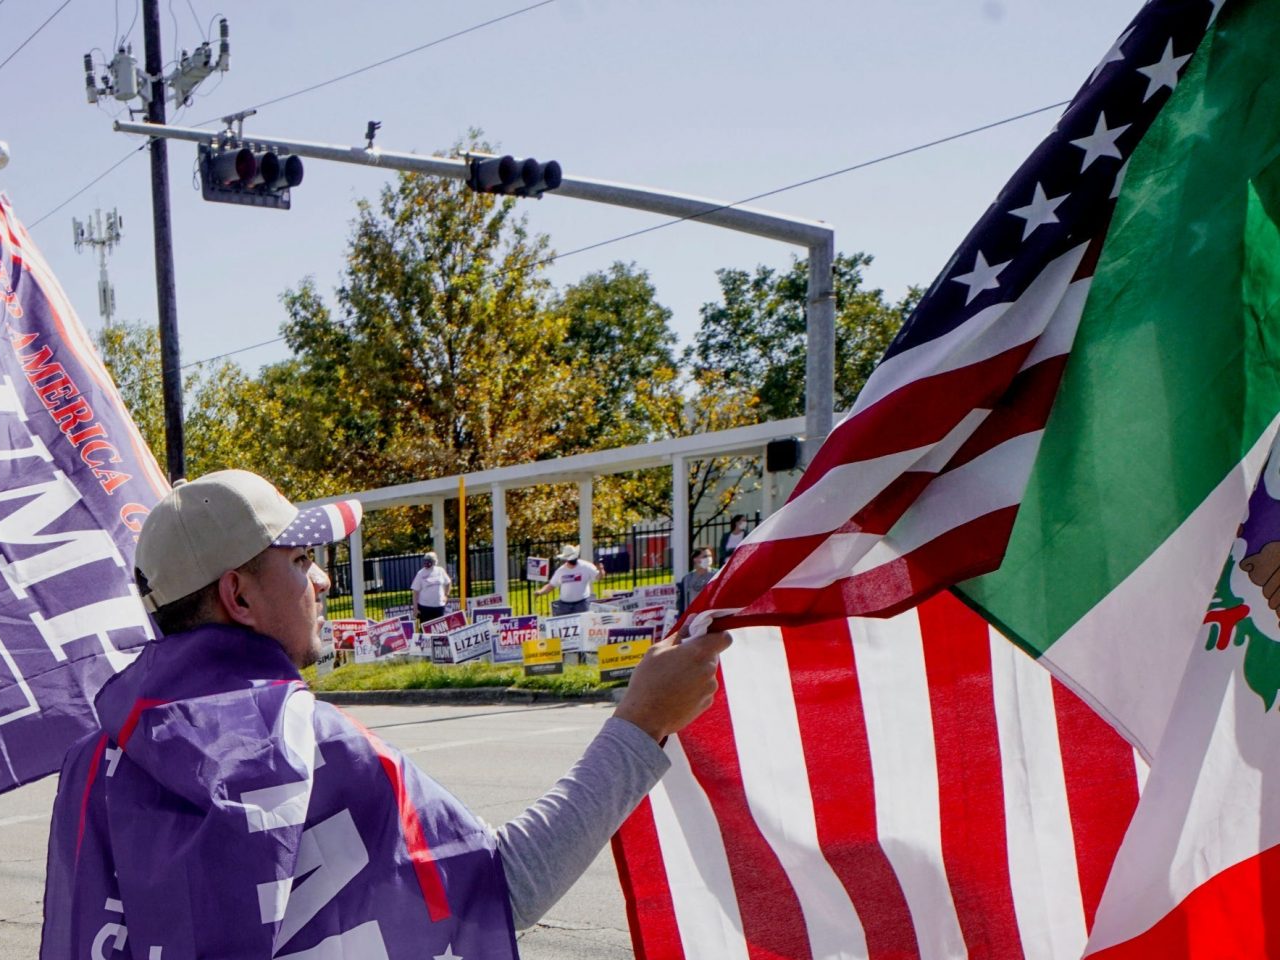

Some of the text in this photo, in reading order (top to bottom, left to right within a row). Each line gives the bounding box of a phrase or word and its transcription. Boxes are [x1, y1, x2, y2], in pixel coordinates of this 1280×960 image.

[6, 322, 133, 496] AMERICA
[500, 621, 519, 631] KYLE
[454, 630, 490, 652] LIZZIE
[500, 629, 538, 646] CARTER
